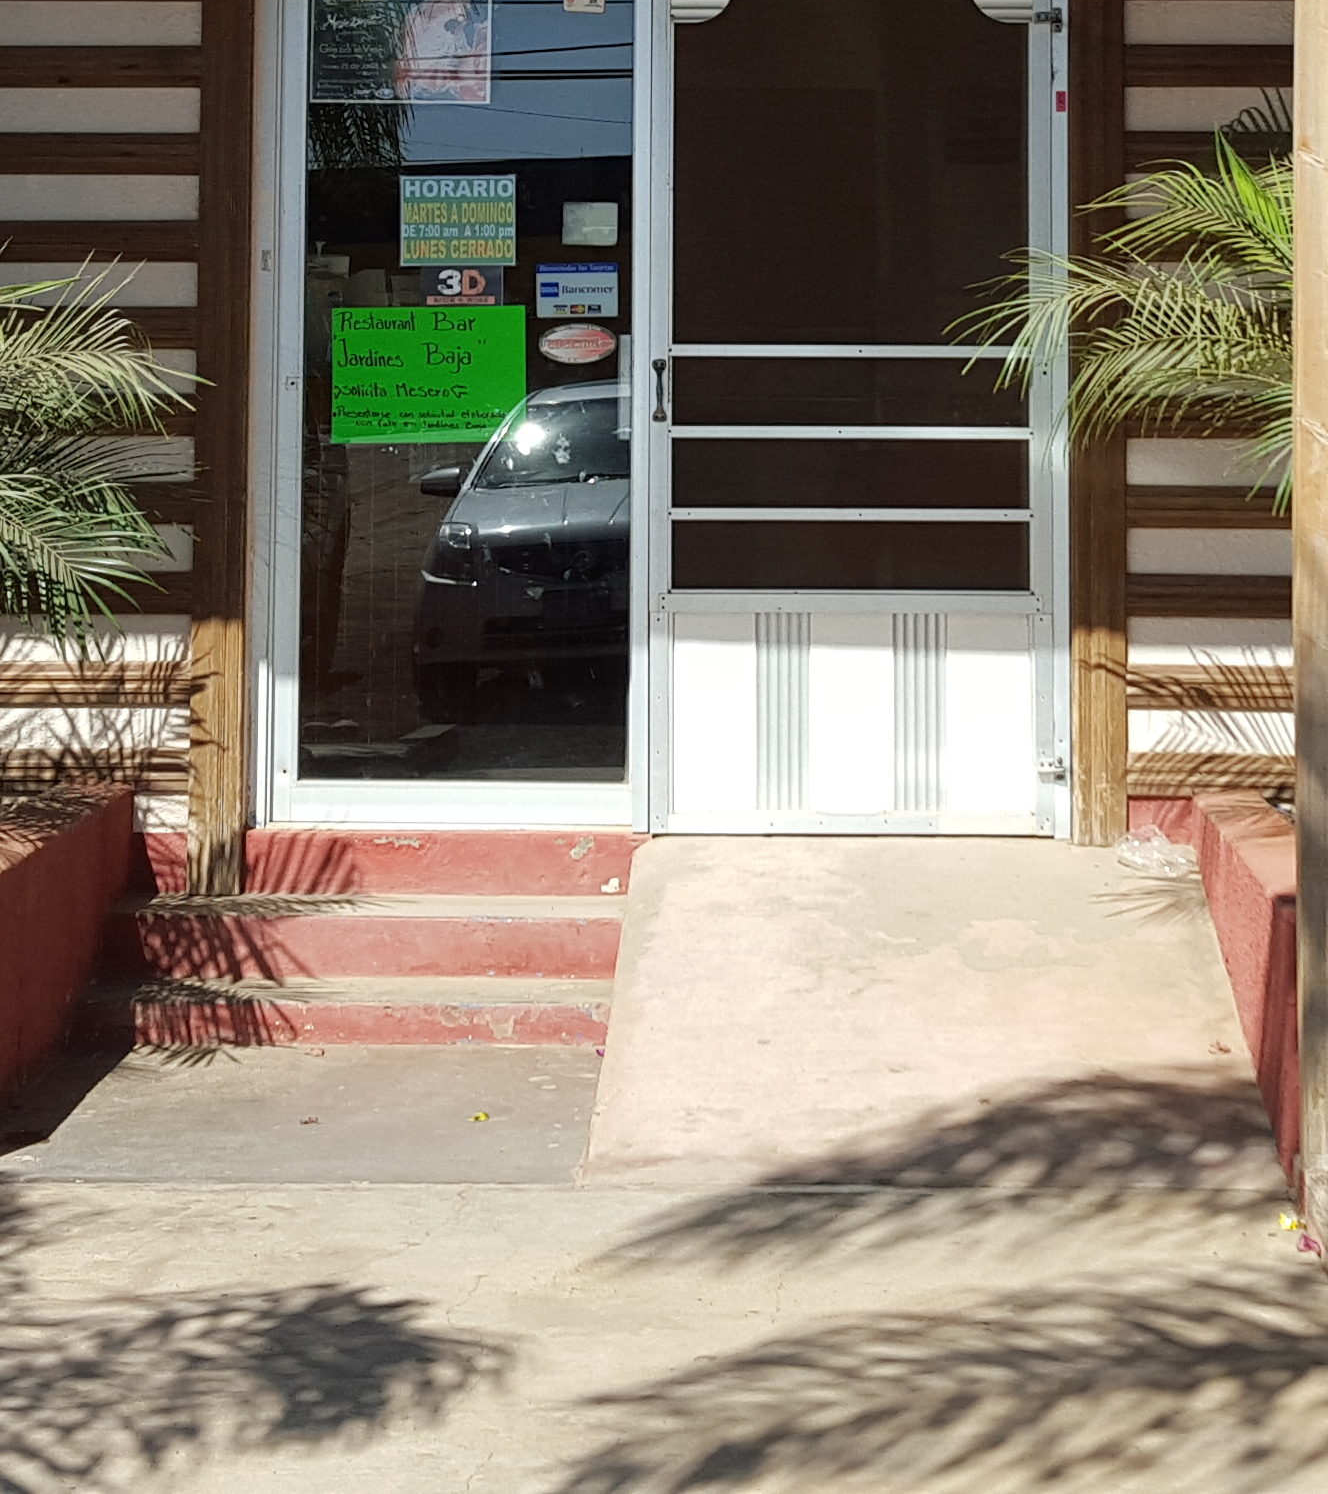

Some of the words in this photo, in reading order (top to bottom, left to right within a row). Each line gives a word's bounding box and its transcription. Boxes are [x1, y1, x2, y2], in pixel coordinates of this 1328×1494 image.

[404, 179, 513, 198] HORARIO
[404, 202, 448, 224] MARTES
[450, 203, 459, 223] A
[461, 202, 513, 223] DOMINGO
[403, 224, 417, 237] DE
[418, 224, 441, 237] 7:00
[443, 227, 459, 237] am
[464, 225, 472, 237] A
[473, 224, 496, 237] 1:00
[498, 227, 514, 239] pm
[404, 239, 447, 259] LUNES
[450, 239, 513, 258] CERRADO
[437, 269, 486, 295] 3D
[562, 285, 614, 294] Bancomer
[335, 310, 416, 332] Restaurant
[431, 311, 476, 331] Bar
[395, 383, 449, 398] Mesero
